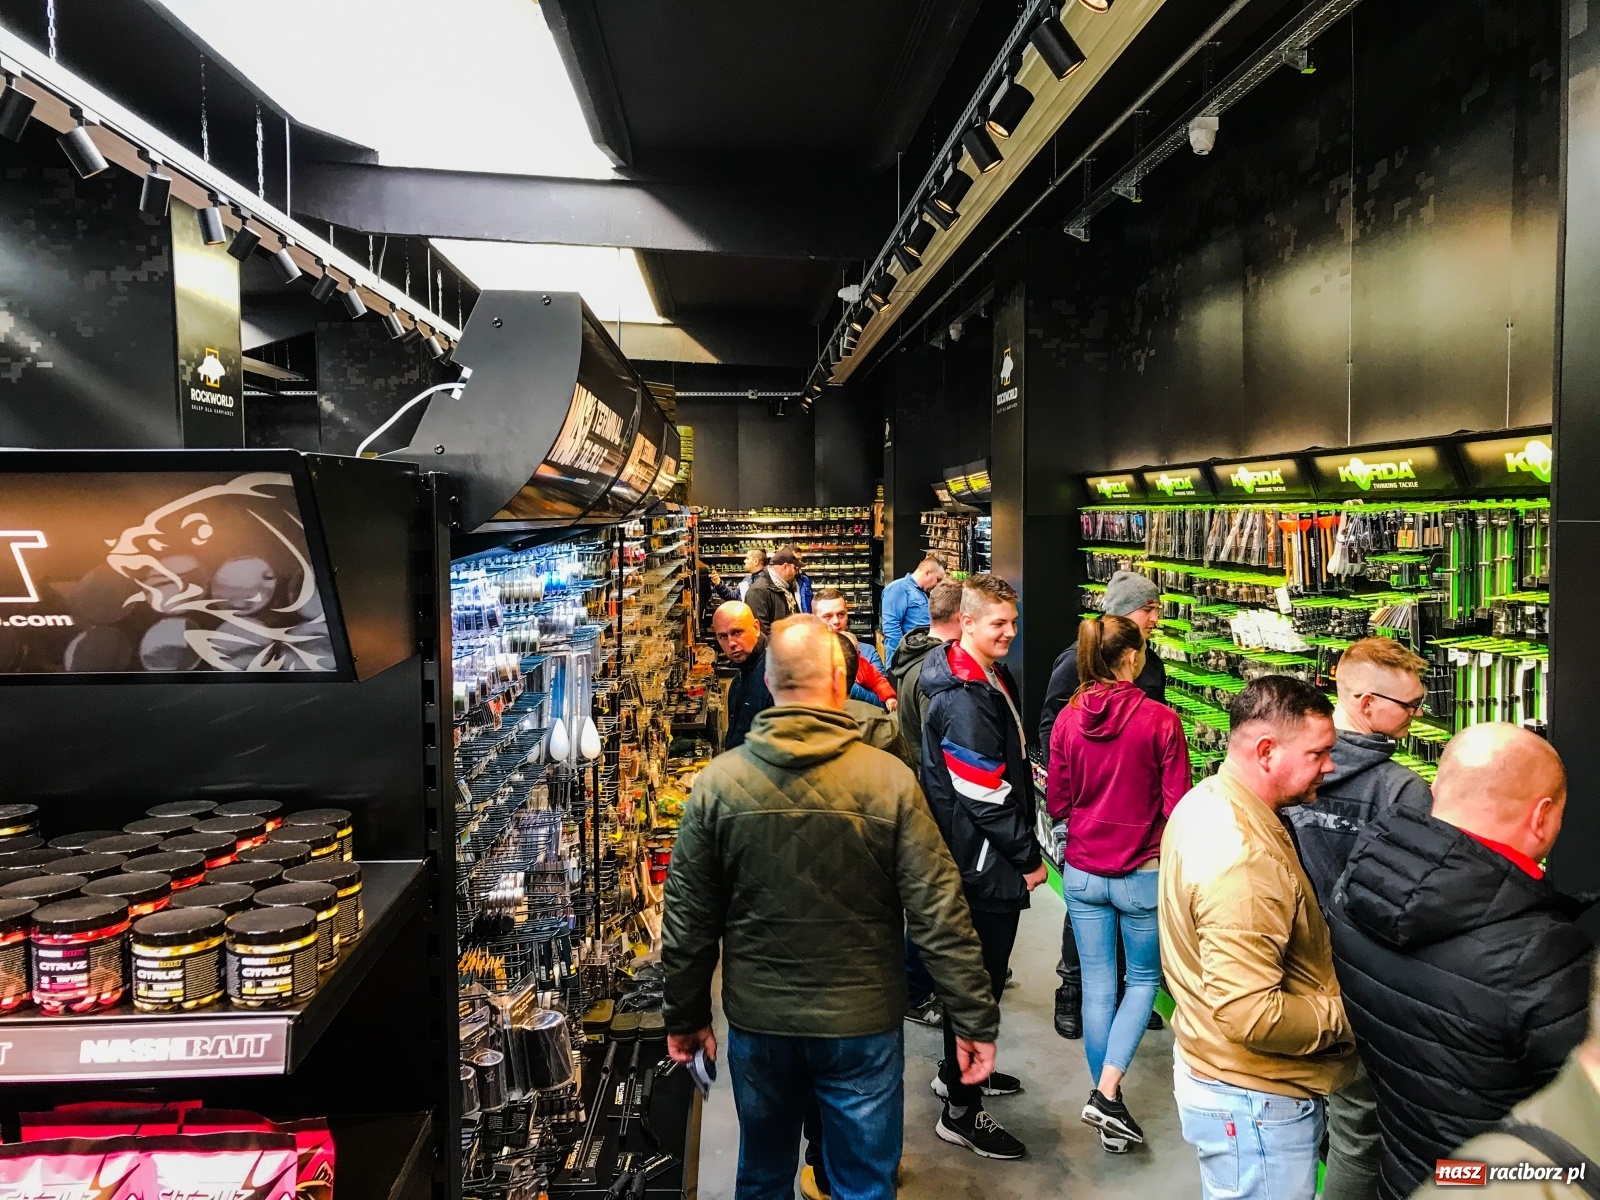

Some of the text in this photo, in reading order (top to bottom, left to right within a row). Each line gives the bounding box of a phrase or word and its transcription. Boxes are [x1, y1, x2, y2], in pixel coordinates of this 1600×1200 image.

[190, 388, 234, 407] ROCKWORLD
[1155, 473, 1193, 497] KORDA
[1230, 466, 1284, 494] KORDA
[1338, 458, 1416, 491] KORDA
[1399, 481, 1418, 489] TACKLE
[79, 1033, 272, 1064] NASHBAIT
